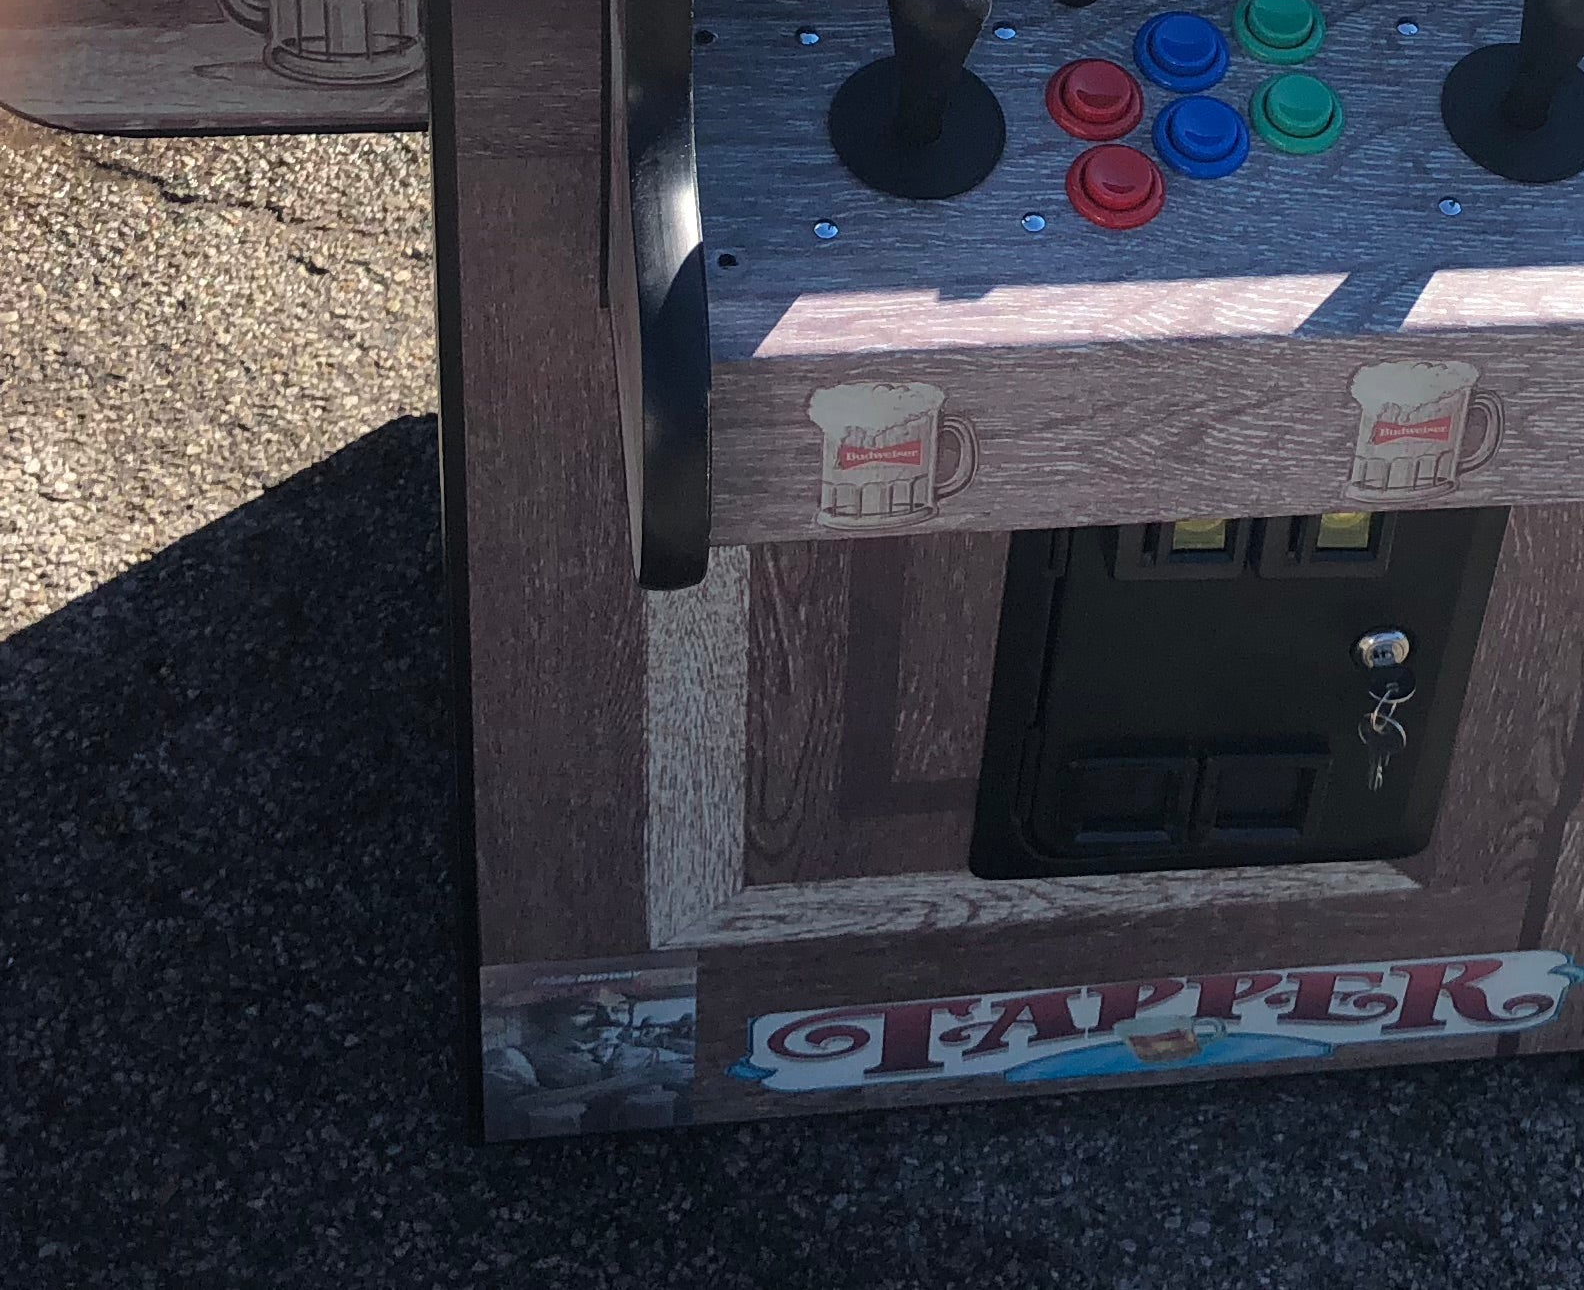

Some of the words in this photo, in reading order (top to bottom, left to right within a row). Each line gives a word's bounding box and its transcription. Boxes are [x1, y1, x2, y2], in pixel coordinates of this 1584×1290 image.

[1379, 424, 1448, 437] Budweiser
[845, 448, 920, 462] Budweiser
[767, 958, 1556, 1079] TAPPER
